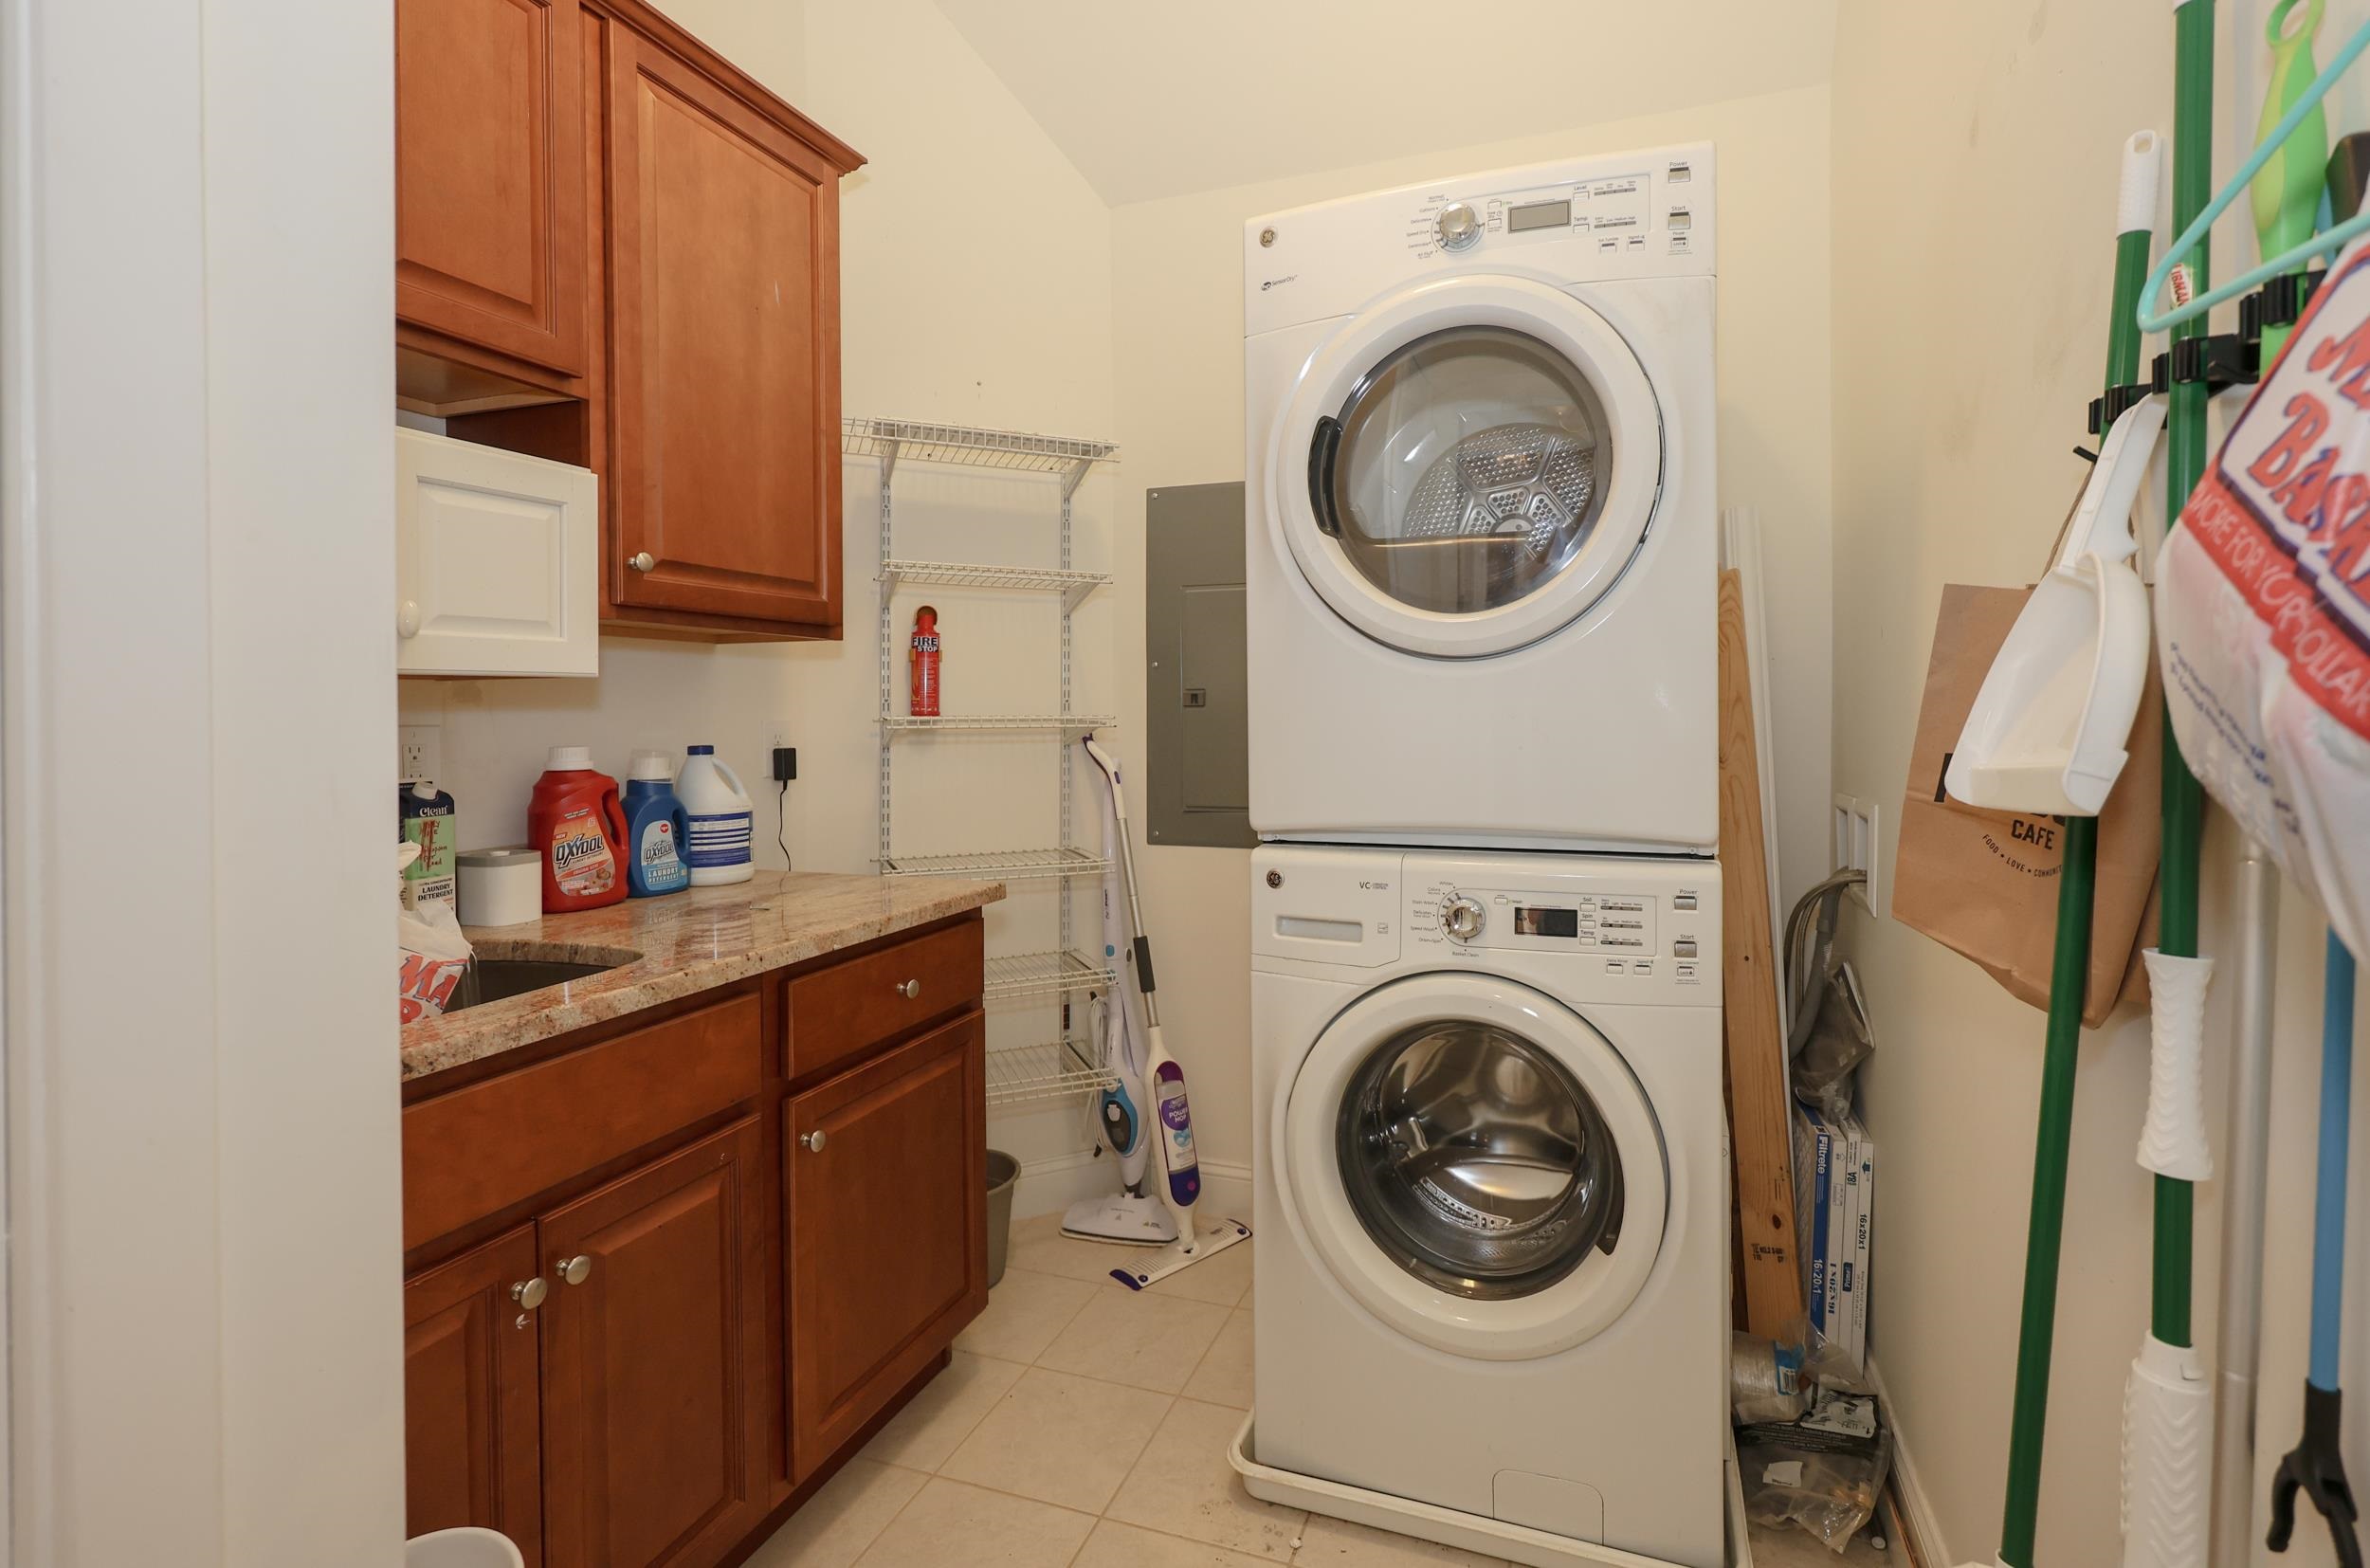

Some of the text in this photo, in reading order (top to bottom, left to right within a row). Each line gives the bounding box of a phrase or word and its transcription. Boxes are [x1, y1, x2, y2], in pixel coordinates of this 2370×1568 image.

[2224, 525, 2268, 580] FOR
[911, 636, 938, 646] FIRE
[917, 645, 938, 653] STOP
[419, 804, 448, 817] Clean
[2011, 819, 2055, 850] CAFE
[554, 833, 605, 869] OXYDOL
[644, 840, 674, 865] OXYDOL
[1982, 833, 2063, 878] FOOD LOVE COMMUNIT
[648, 867, 678, 878] LAUNDRY
[417, 889, 453, 902] DETERGENT
[422, 883, 450, 894] LAUNDRY
[1817, 1136, 1829, 1175] Filtrete
[1858, 1213, 1868, 1250] 16x20x1
[1812, 1259, 1823, 1294] 16x20x1
[1828, 1263, 1837, 1315] 16x20x1
